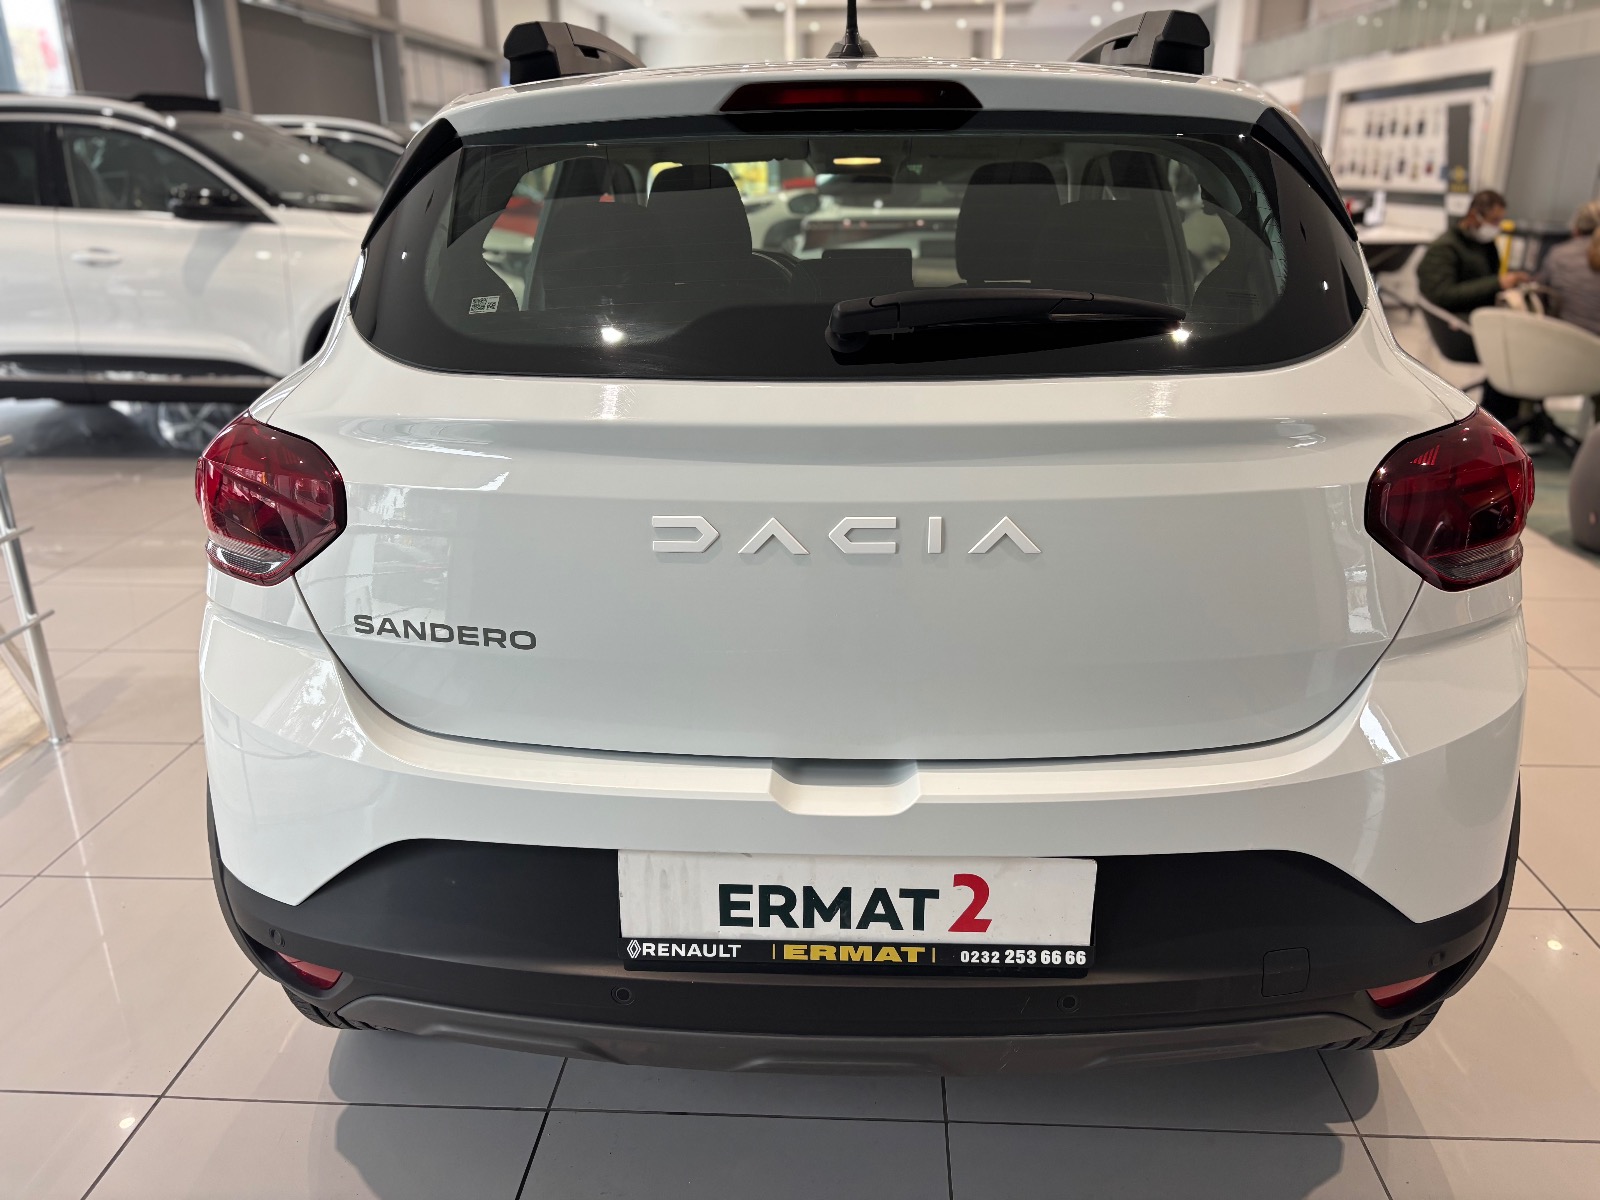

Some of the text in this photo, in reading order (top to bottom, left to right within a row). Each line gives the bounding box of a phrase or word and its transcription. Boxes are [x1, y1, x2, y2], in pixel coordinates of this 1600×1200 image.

[652, 515, 1042, 555] DACIA
[353, 613, 537, 650] SANDERO
[718, 873, 992, 933] ERMAT 2
[642, 942, 1087, 966] RENAULT ERMAT 0232 253 66 66
